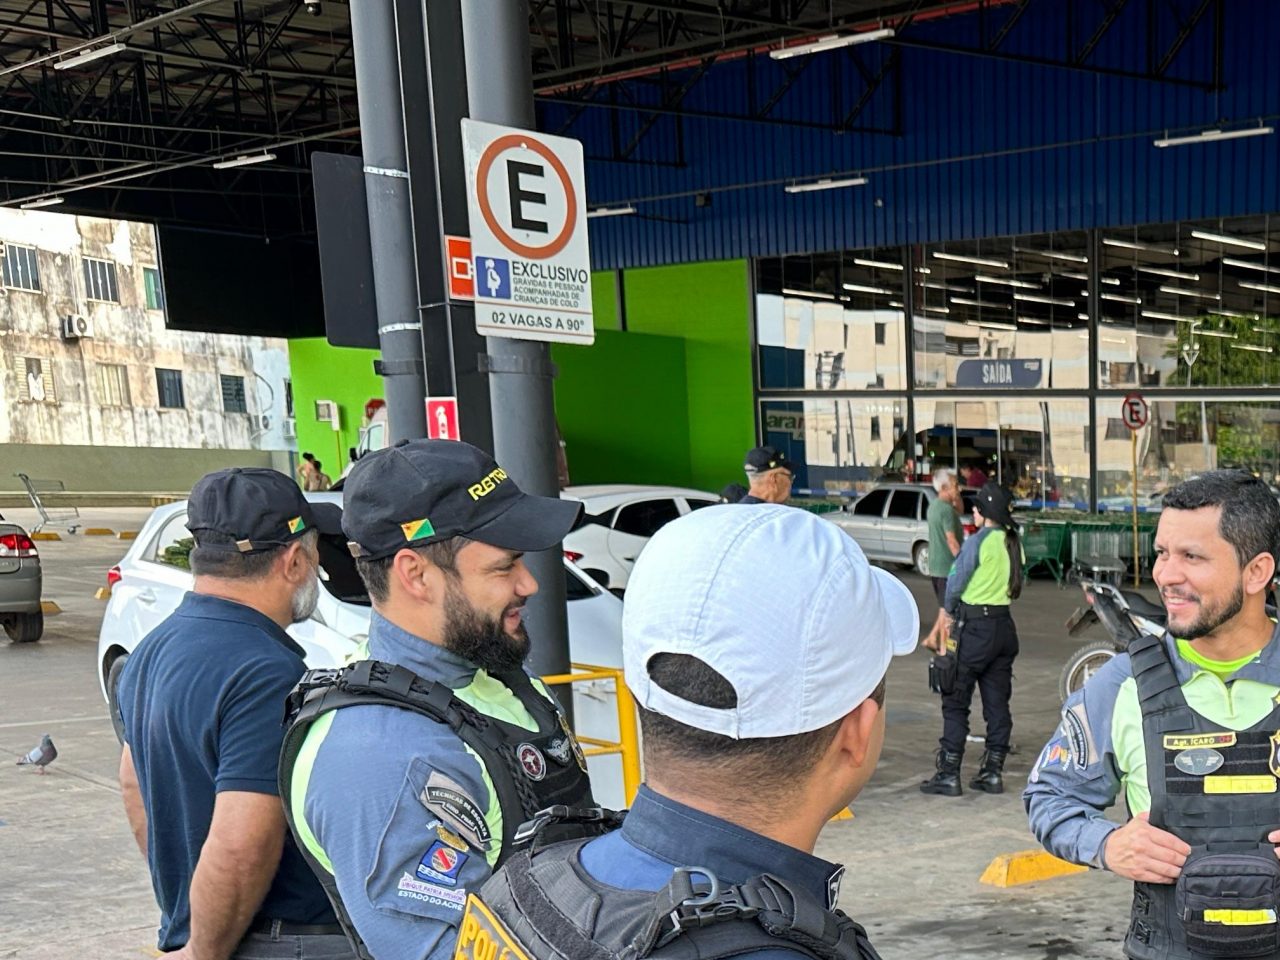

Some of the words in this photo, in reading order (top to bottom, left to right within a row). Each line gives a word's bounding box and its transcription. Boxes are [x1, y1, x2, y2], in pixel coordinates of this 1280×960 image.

[507, 159, 548, 233] E
[512, 261, 588, 284] EXCLUSIVO
[514, 286, 570, 299] ACOMPANHADAS
[571, 292, 580, 300] DE
[554, 282, 585, 293] PESSOAS
[549, 298, 559, 306] DE
[492, 311, 506, 325] 02
[508, 313, 552, 328] VAGAS
[556, 318, 564, 330] A
[982, 361, 1013, 384] SAÍDA
[398, 890, 429, 902] ESTADO
[429, 898, 442, 906] DO
[441, 901, 464, 911] ACRE
